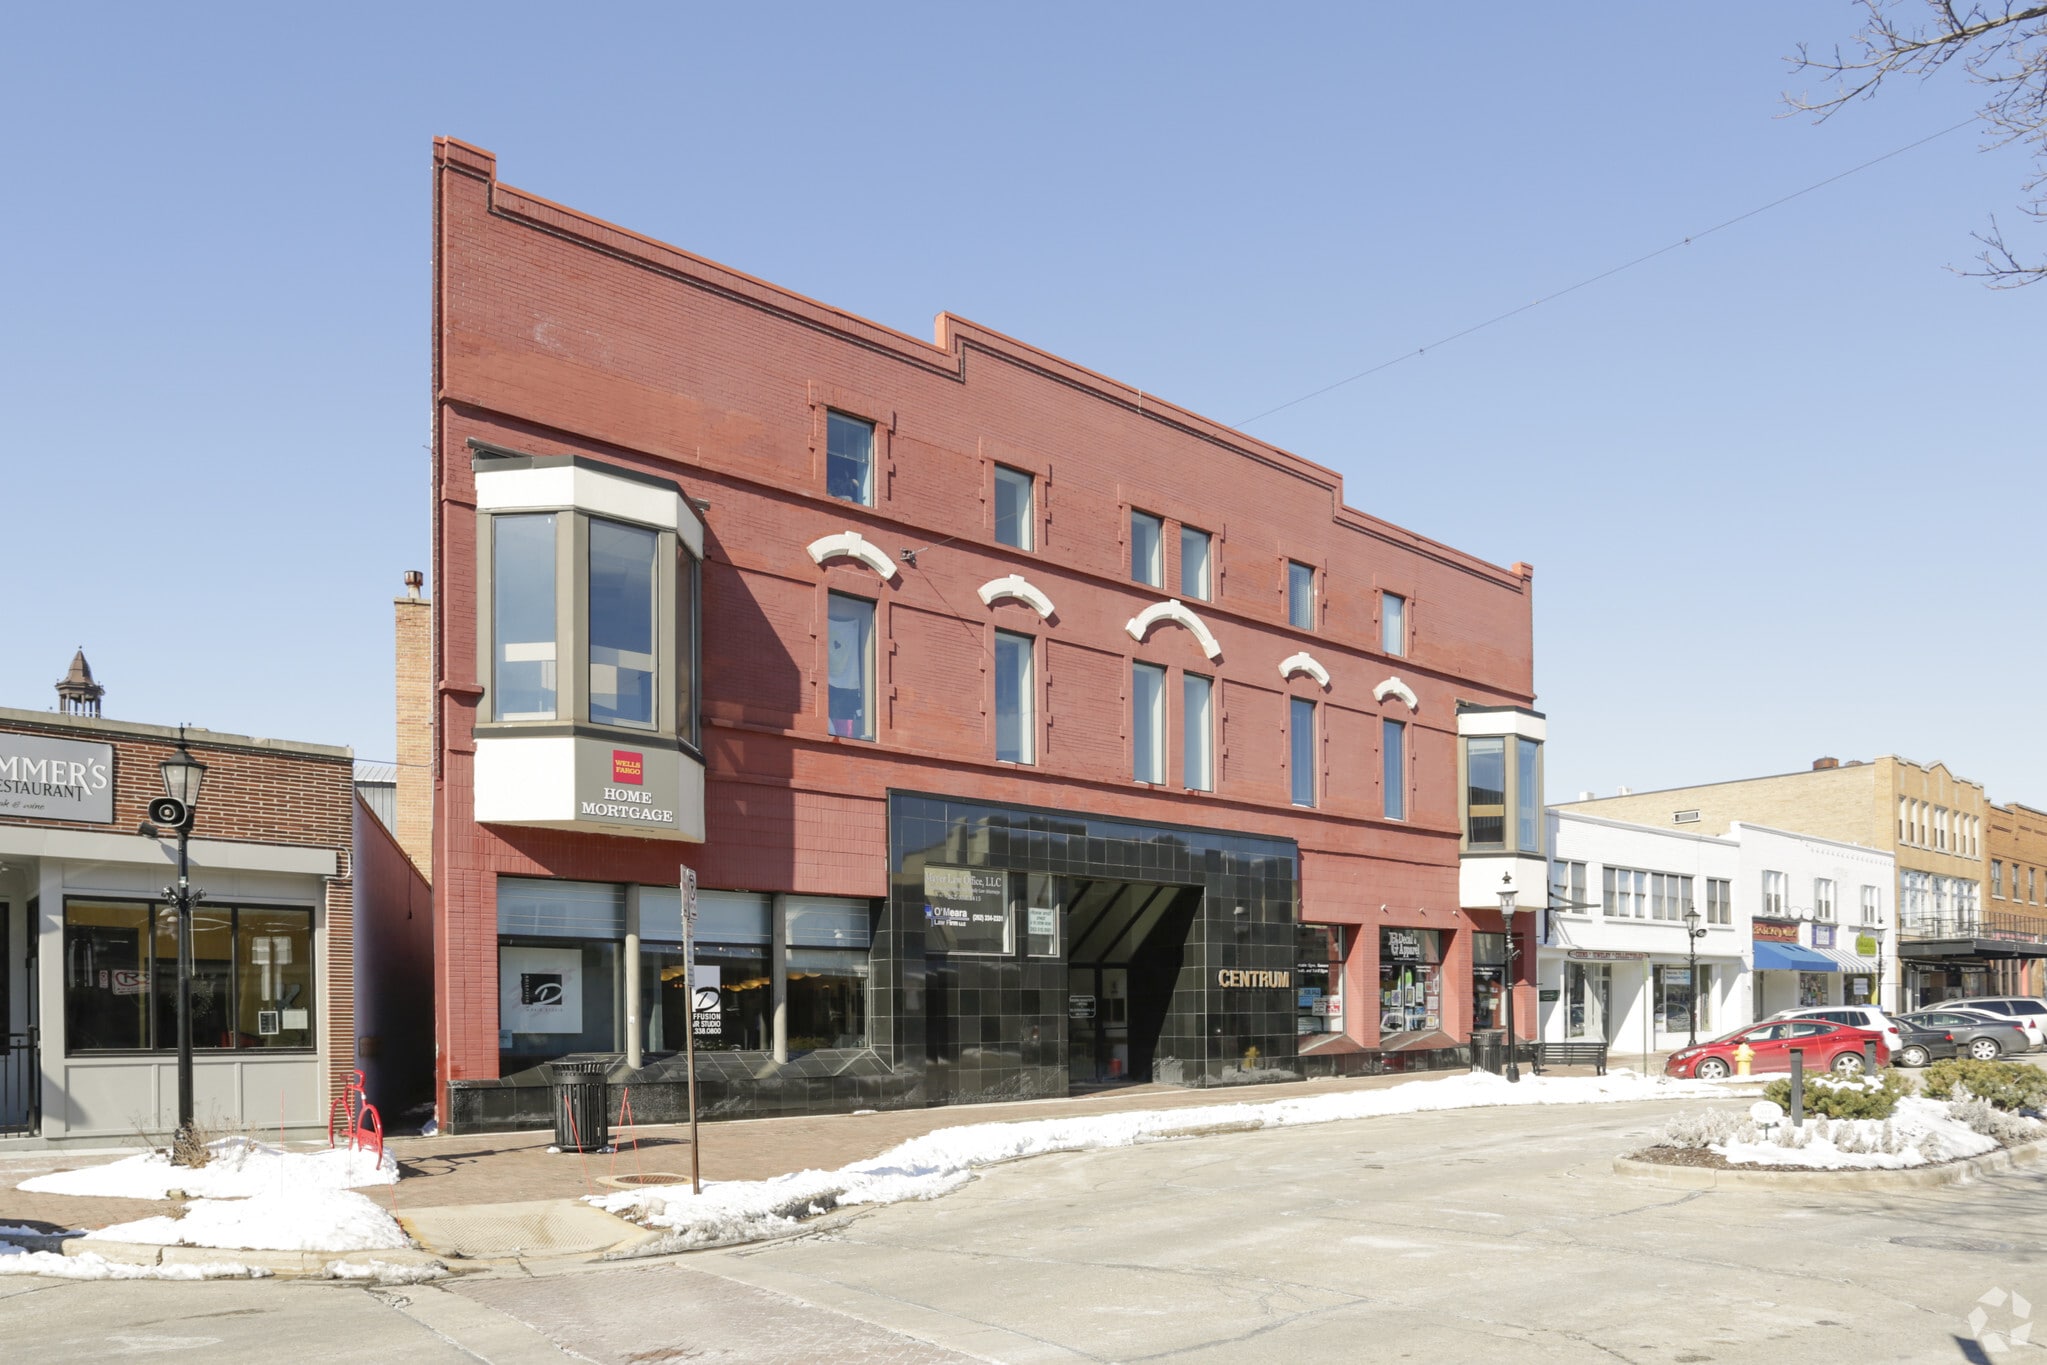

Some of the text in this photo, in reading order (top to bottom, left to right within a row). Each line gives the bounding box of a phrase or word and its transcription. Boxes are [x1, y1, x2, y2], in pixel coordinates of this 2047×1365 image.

[615, 759, 641, 769] WELLS
[615, 767, 641, 775] FARGO
[603, 787, 652, 805] HOME
[581, 801, 673, 822] MORTGAGE
[986, 876, 1002, 888] LLC
[934, 907, 967, 918] O'Meara
[1218, 968, 1290, 988] CENTRUM
[701, 1020, 721, 1028] STUDIO
